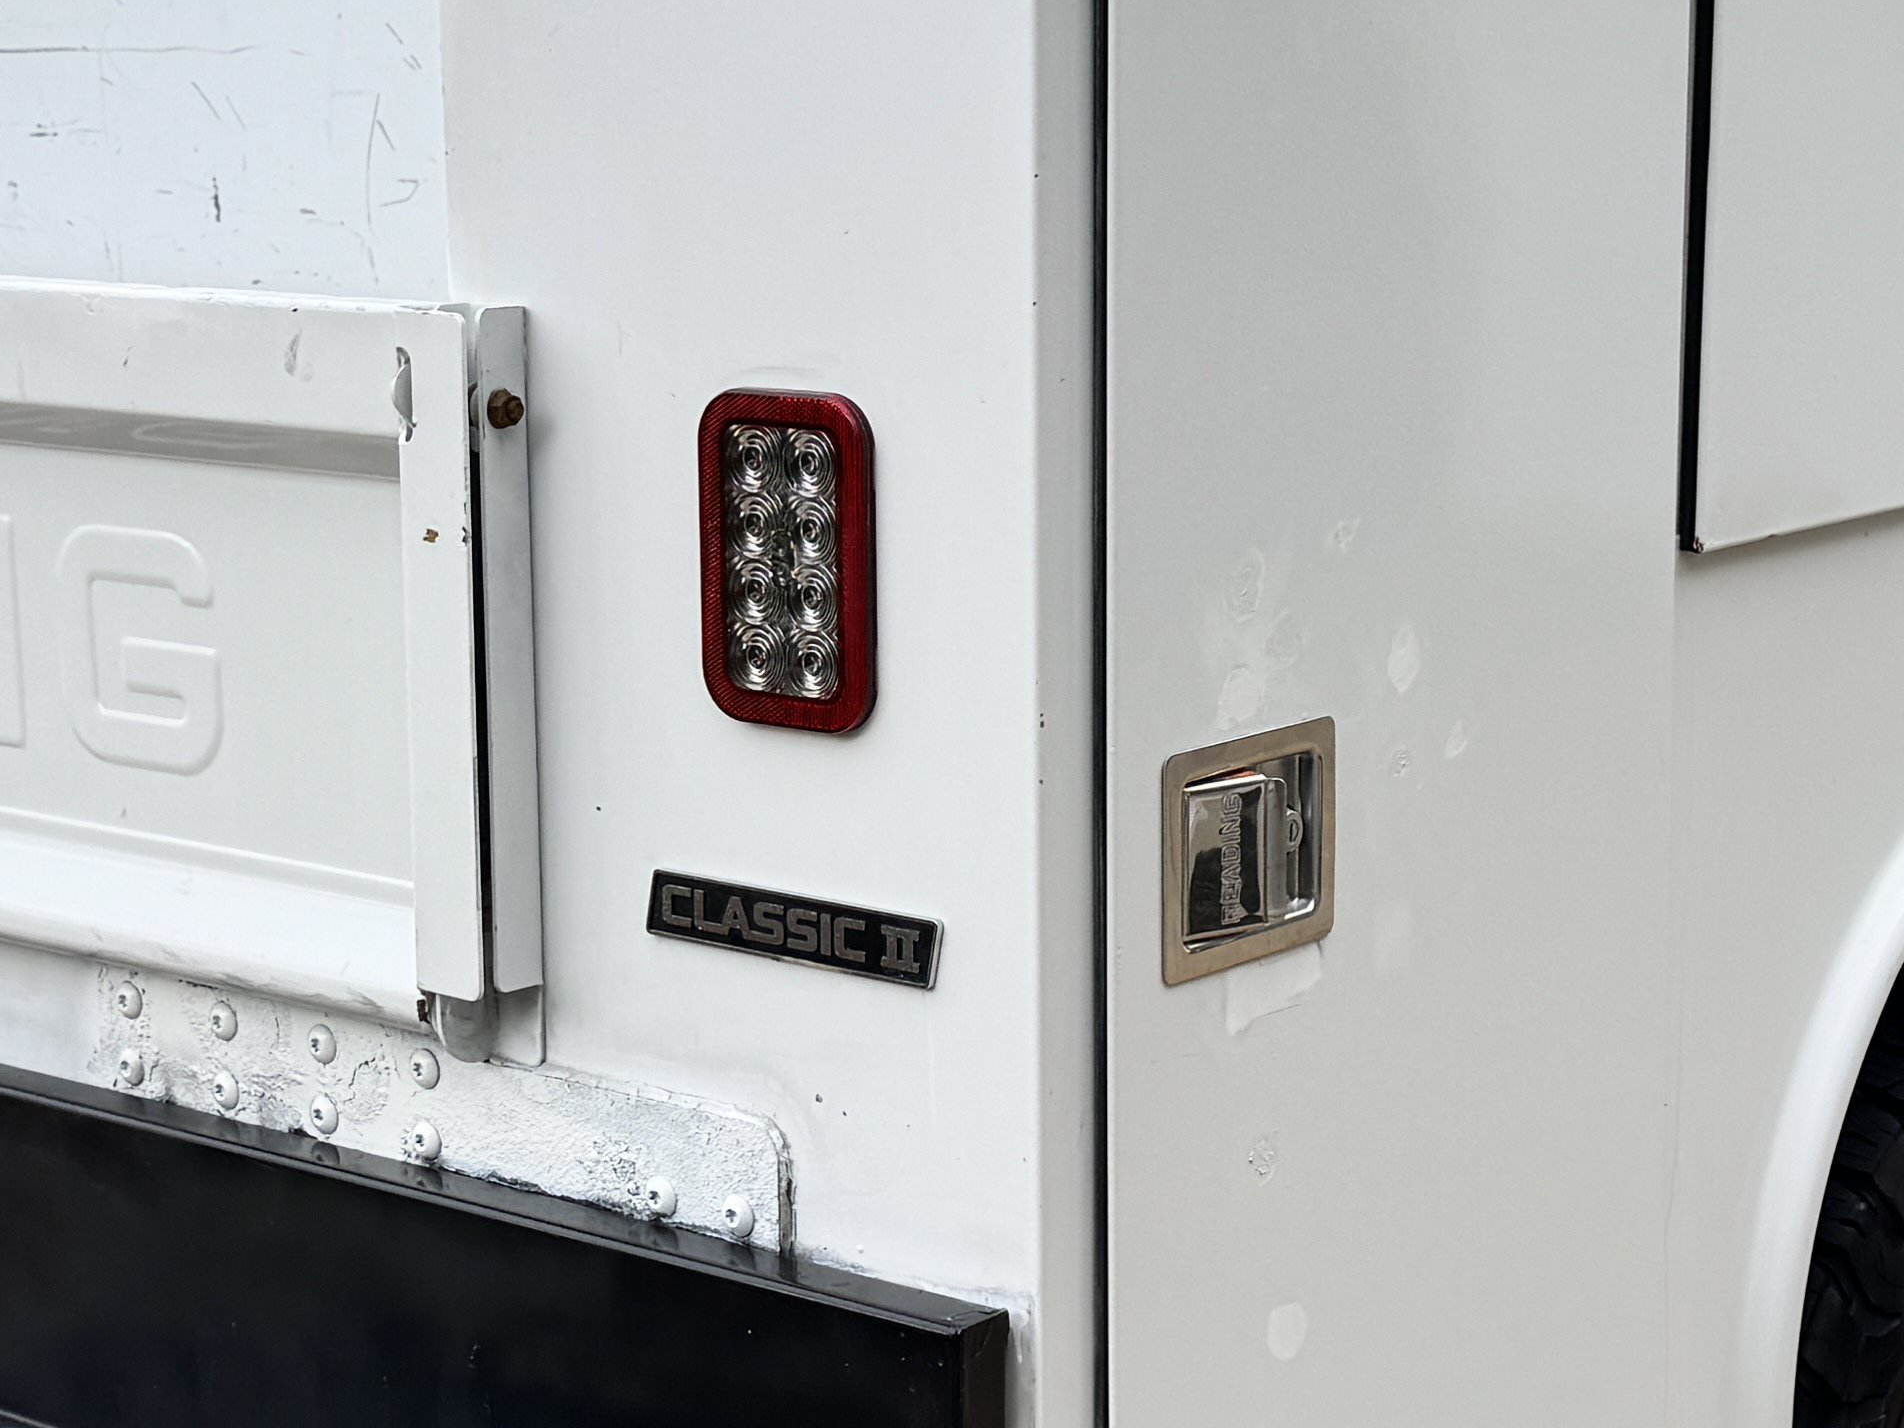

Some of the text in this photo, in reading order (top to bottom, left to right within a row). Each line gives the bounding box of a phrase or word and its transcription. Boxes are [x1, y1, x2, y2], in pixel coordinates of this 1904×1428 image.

[1219, 791, 1244, 926] READING
[660, 883, 921, 974] CLASSIC II
